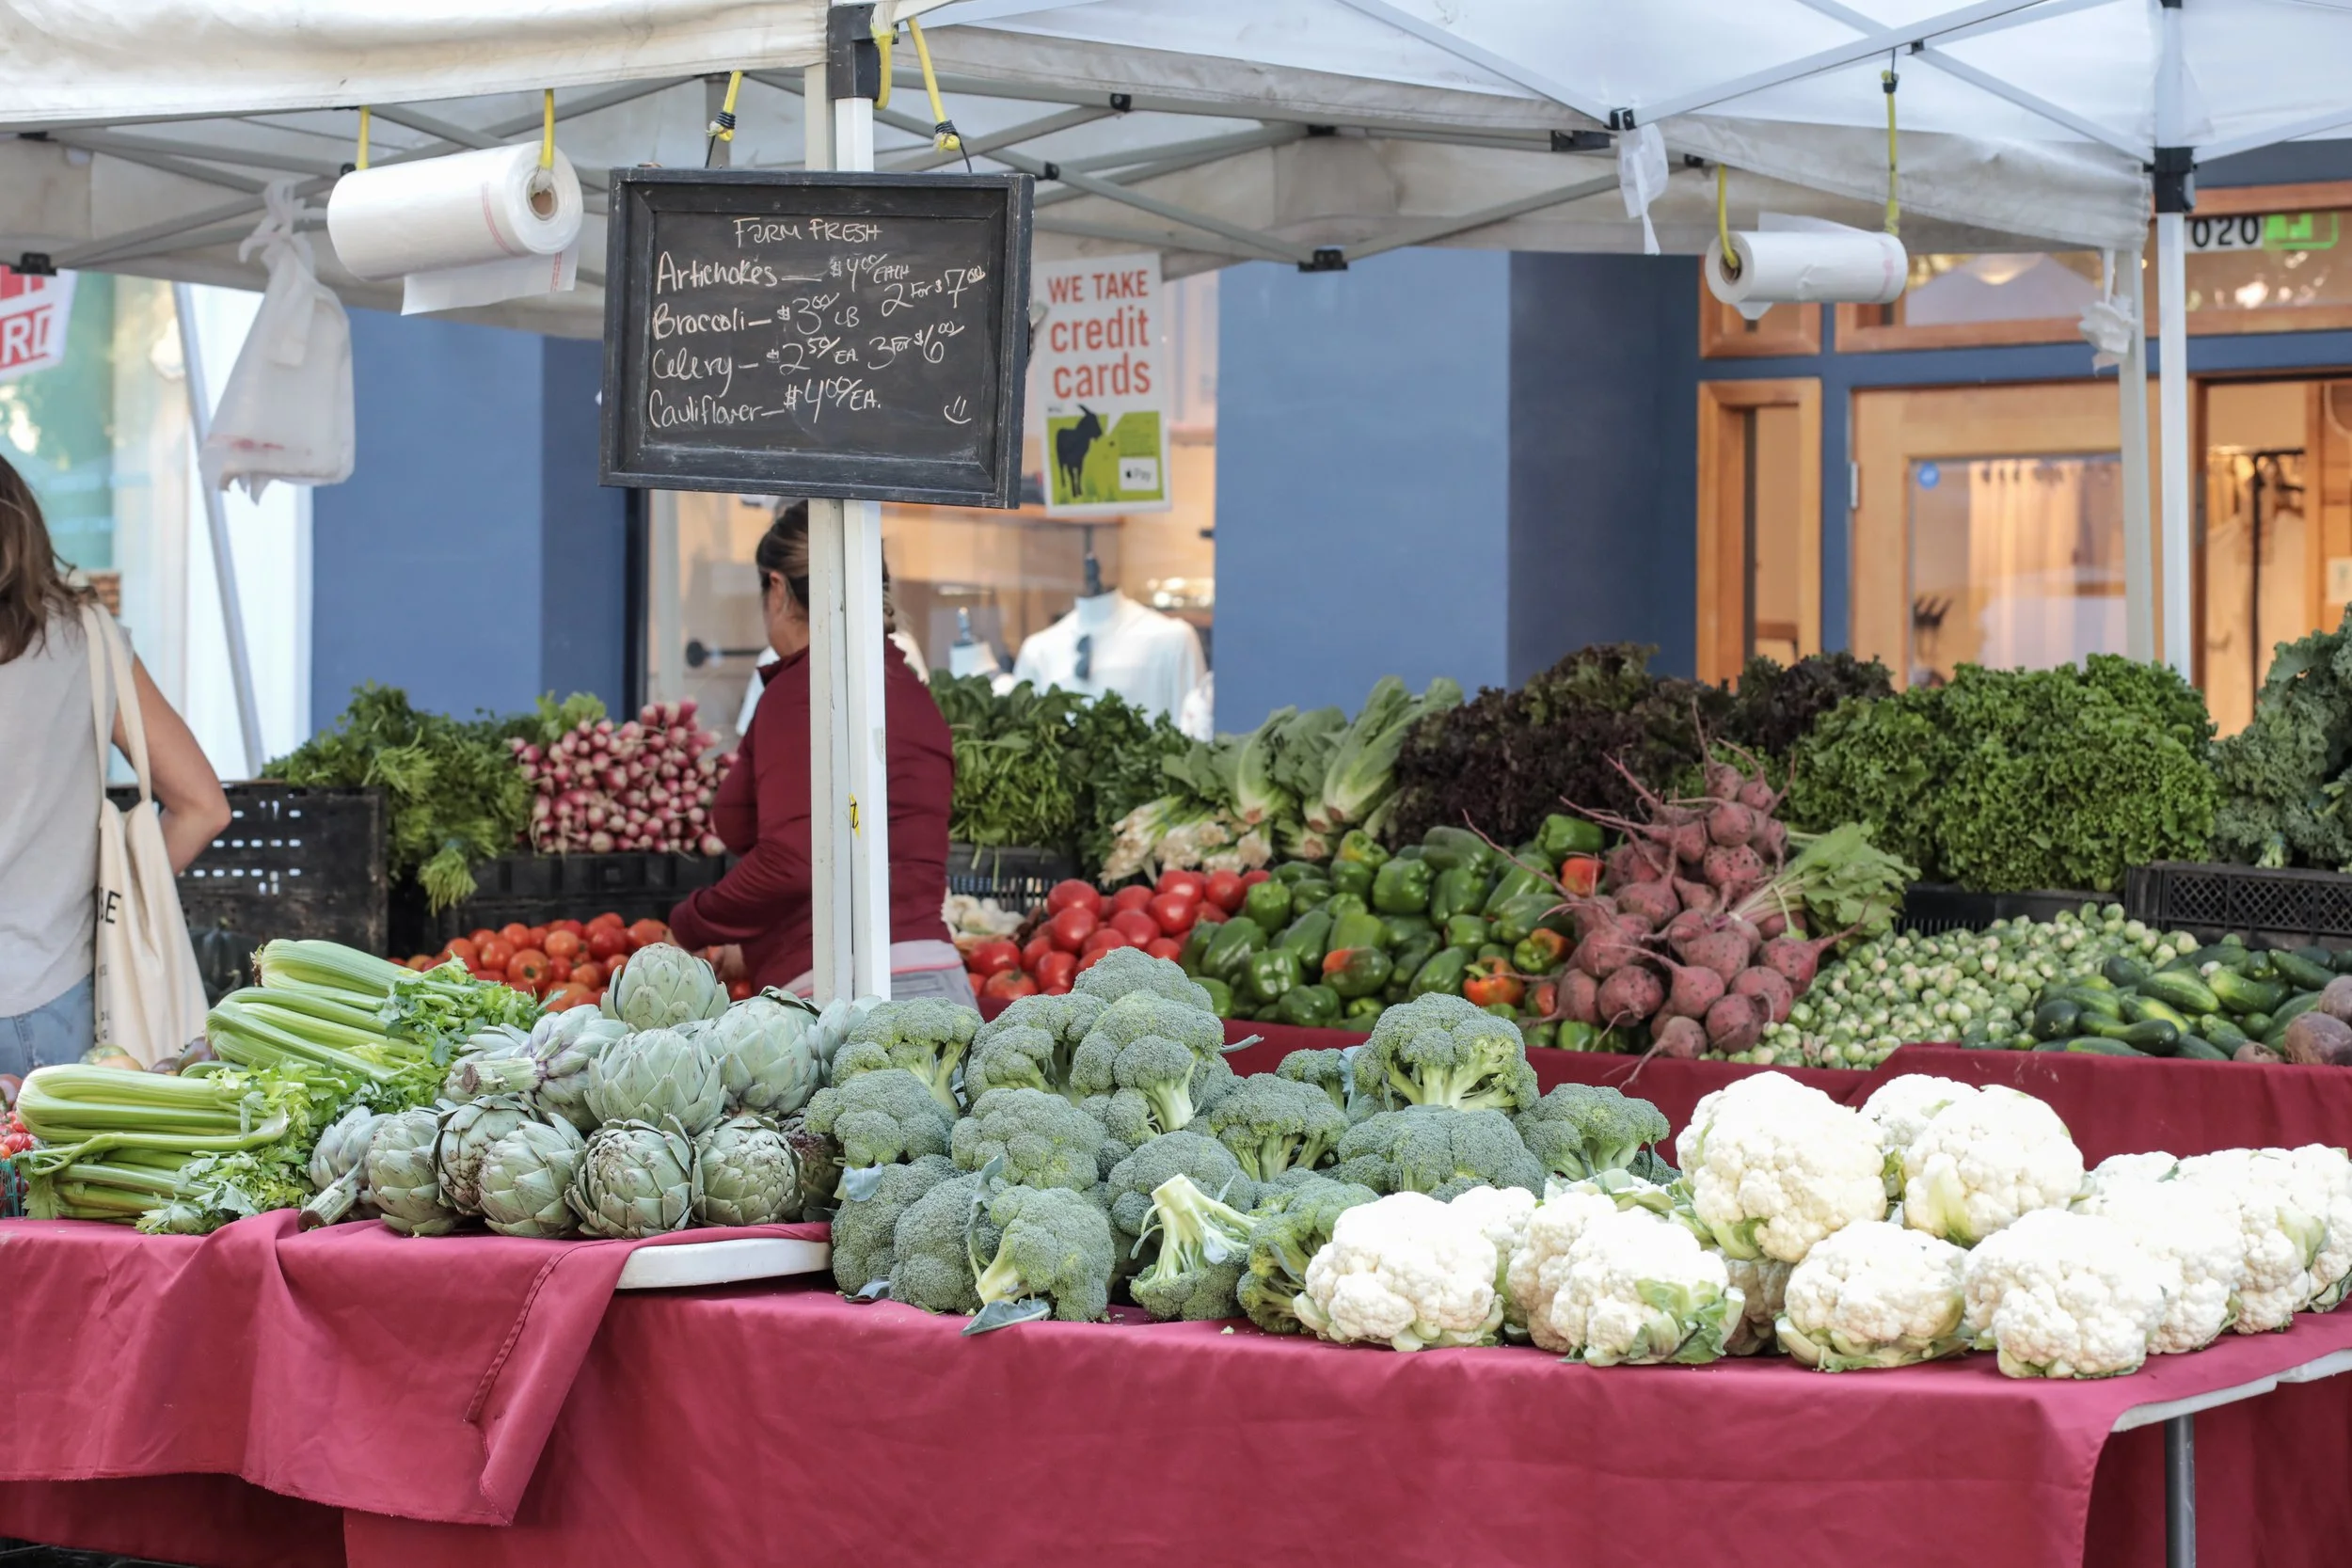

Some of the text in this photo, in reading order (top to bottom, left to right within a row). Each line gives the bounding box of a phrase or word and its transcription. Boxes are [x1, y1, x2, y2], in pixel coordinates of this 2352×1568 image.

[808, 218, 882, 243] FRESH
[657, 251, 778, 294] Artichokes
[1048, 270, 1148, 304] WE TAKE
[652, 302, 745, 341] Broccoli
[1050, 306, 1150, 354] credit
[653, 347, 733, 398] Celery
[1053, 353, 1151, 399] cards
